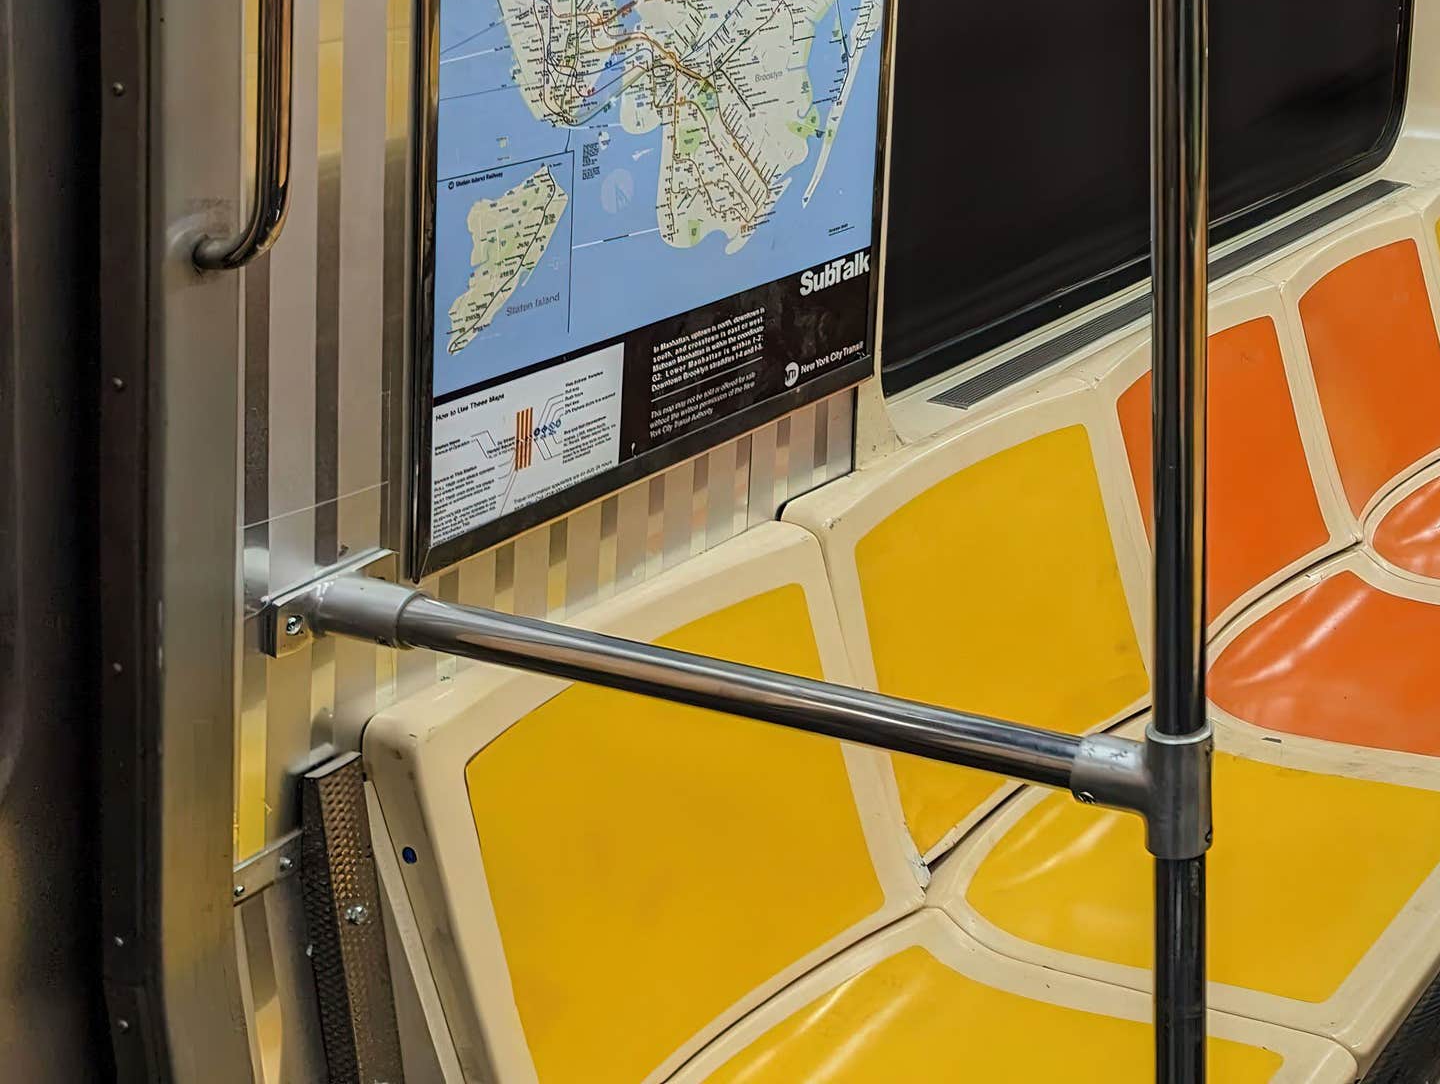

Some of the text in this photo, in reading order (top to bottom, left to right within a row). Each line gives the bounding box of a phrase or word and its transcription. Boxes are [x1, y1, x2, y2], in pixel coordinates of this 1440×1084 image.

[799, 251, 871, 298] SubTalk
[800, 340, 865, 375] New York City Transit
